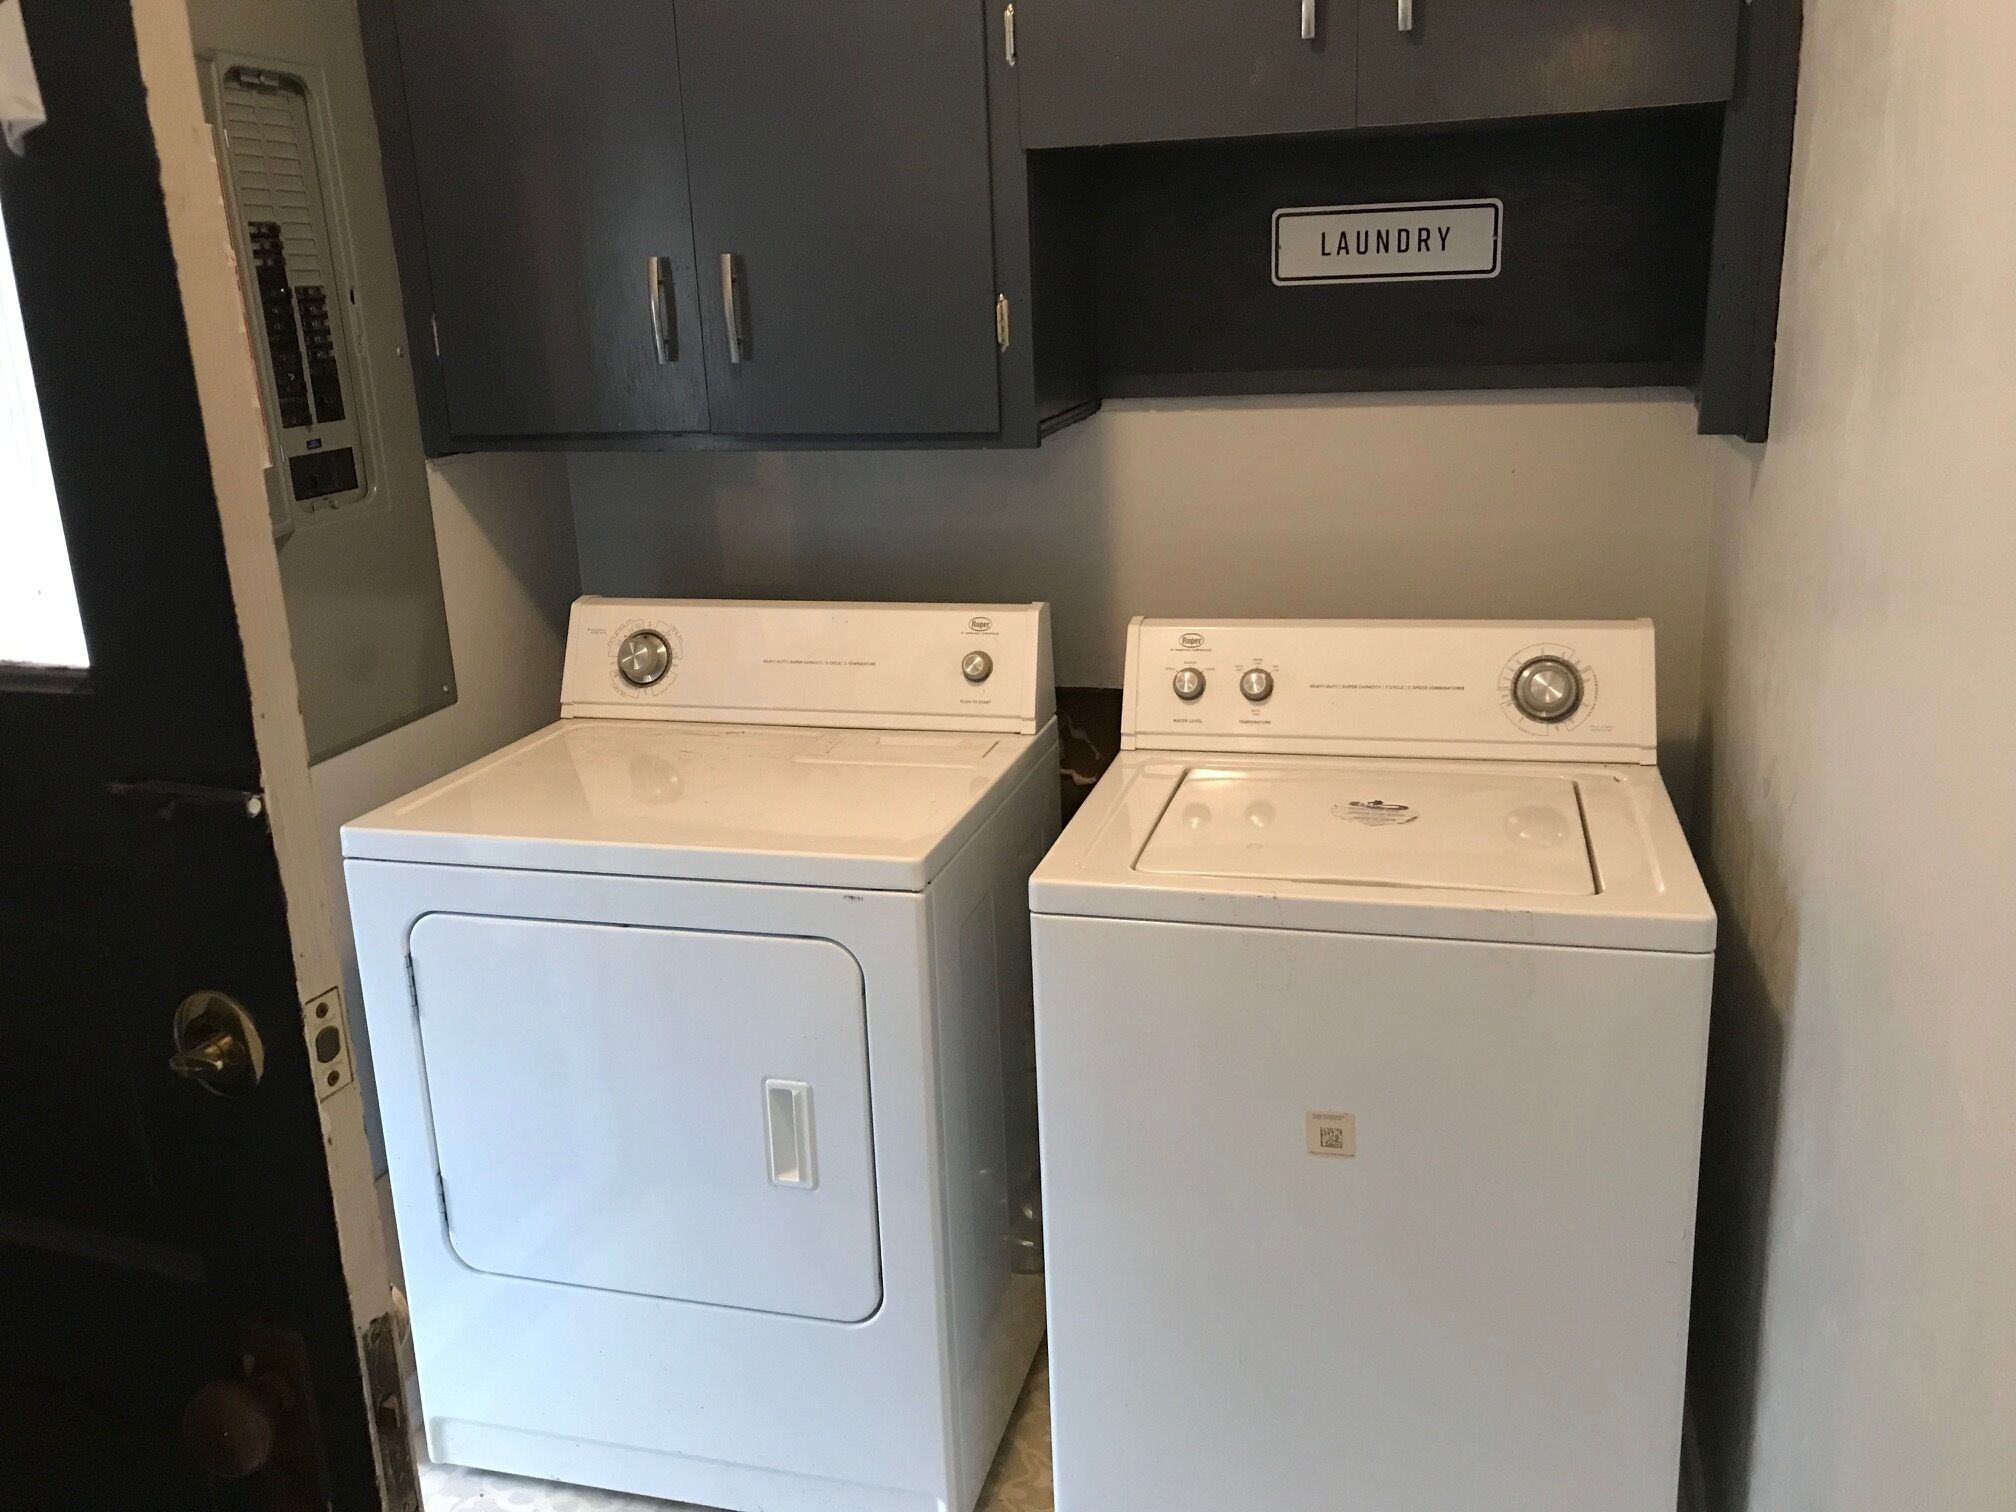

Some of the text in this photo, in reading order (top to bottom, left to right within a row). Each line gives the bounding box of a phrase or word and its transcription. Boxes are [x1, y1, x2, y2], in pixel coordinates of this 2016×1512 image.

[1320, 226, 1451, 257] LAUNDRY
[971, 620, 990, 629] Roper
[1181, 636, 1202, 645] Roper
